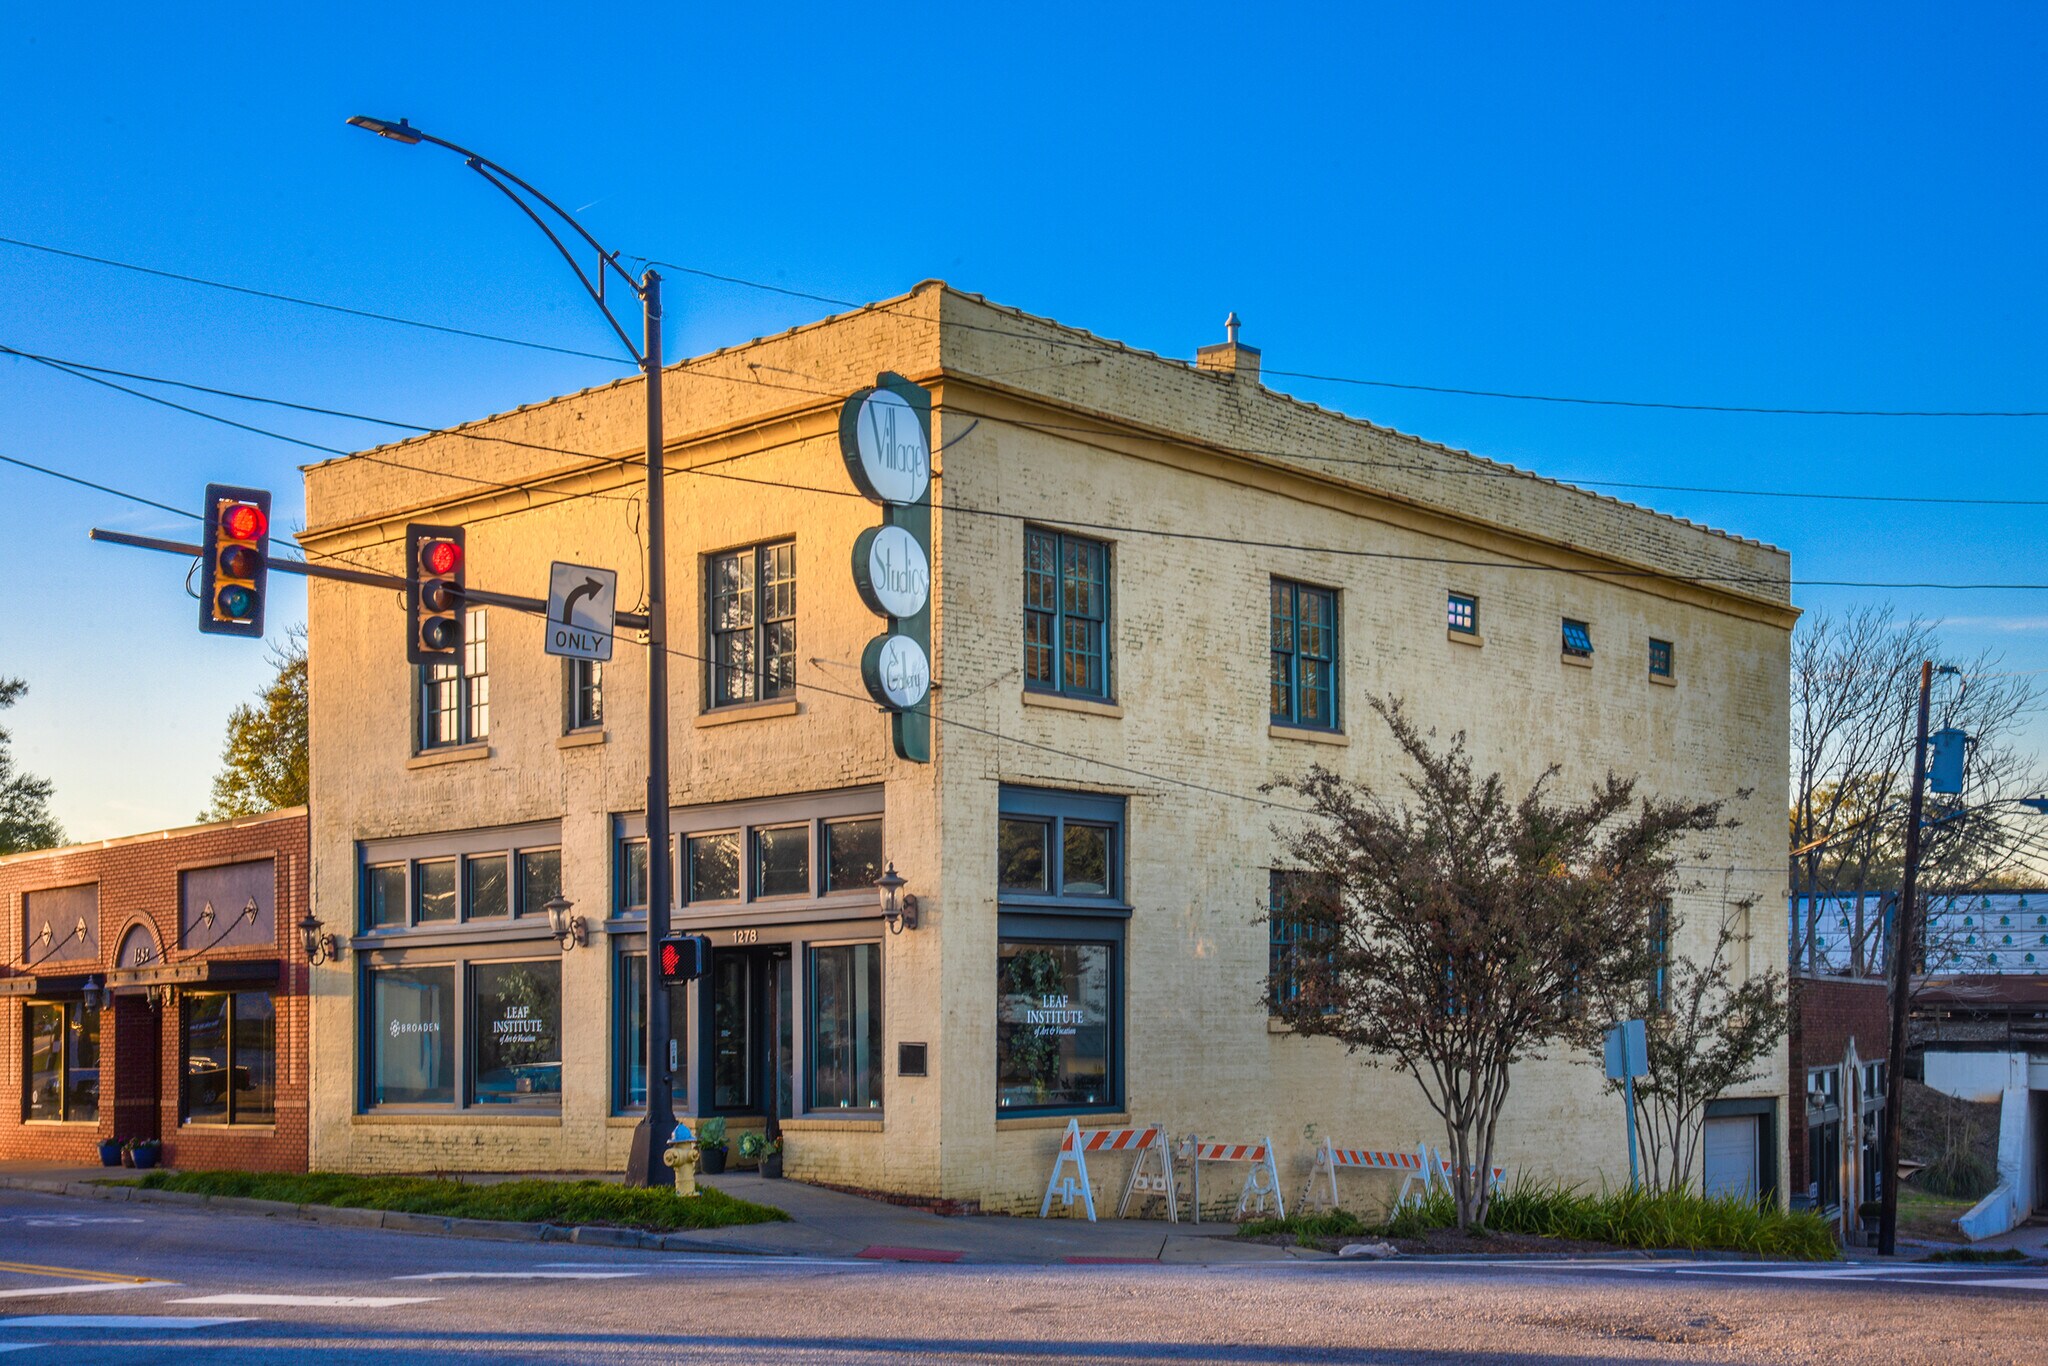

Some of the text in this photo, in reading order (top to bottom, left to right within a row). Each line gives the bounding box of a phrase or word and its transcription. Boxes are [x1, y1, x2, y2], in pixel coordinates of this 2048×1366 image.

[868, 400, 923, 500] Village
[873, 536, 926, 596] Studios
[555, 630, 604, 652] ONLY
[732, 929, 757, 943] 1278
[1043, 994, 1068, 1008] LEAF
[507, 1006, 530, 1019] LEAF
[1027, 1009, 1084, 1024] INSTITUTE
[401, 1022, 440, 1033] BROADEN
[493, 1019, 543, 1033] INSTITUTE
